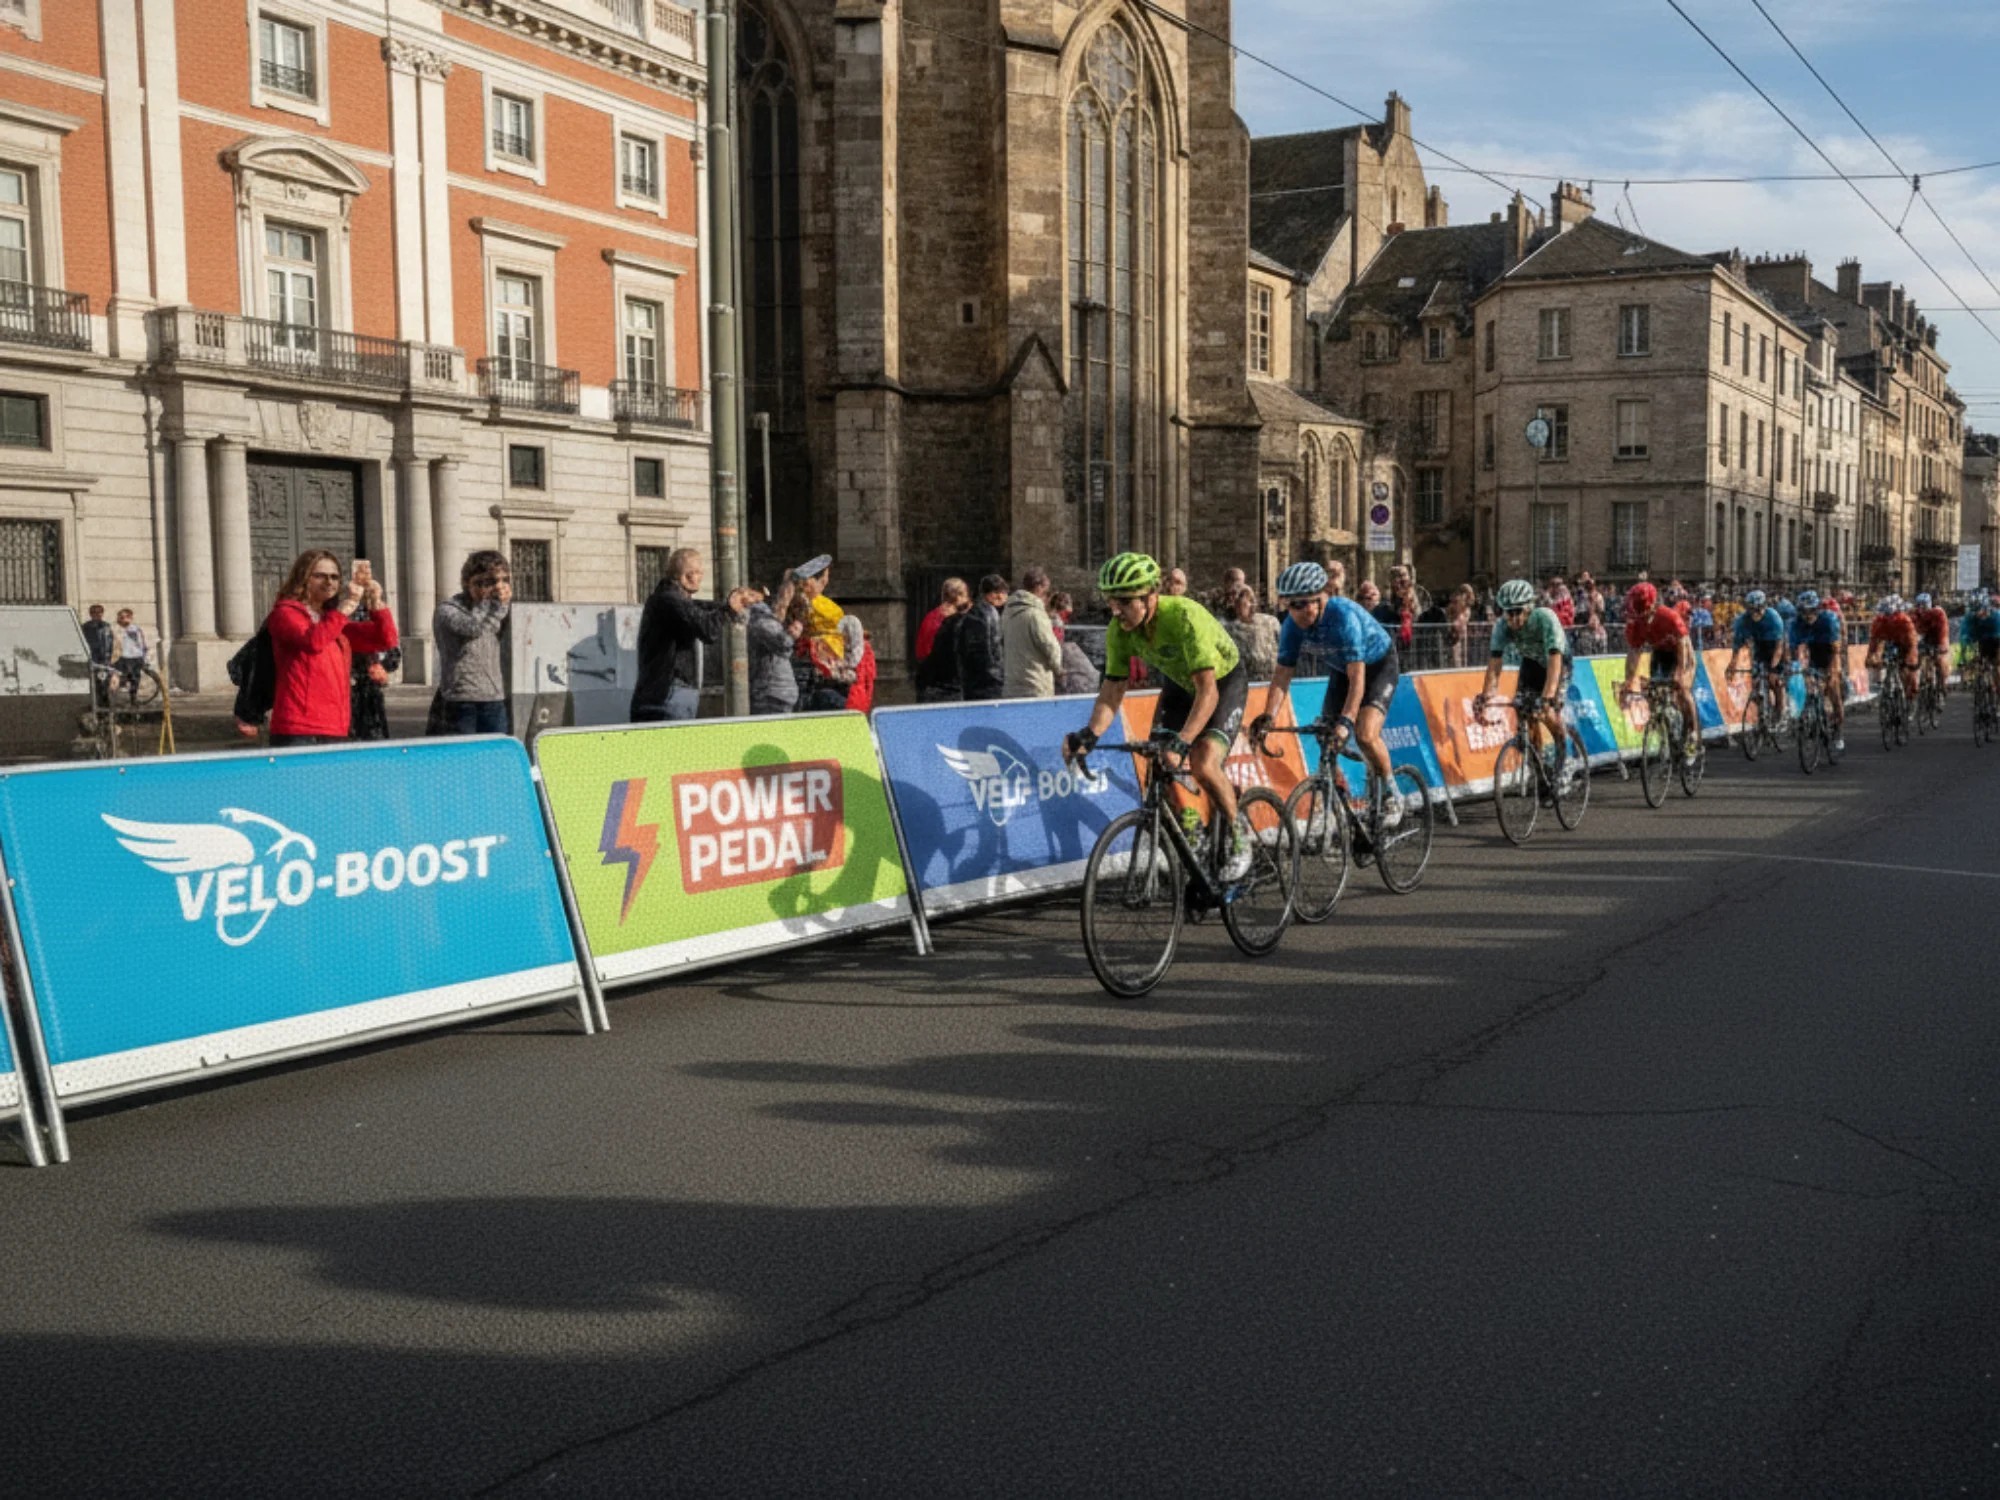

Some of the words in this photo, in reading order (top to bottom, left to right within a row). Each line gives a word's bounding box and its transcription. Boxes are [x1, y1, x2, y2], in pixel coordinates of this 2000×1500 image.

[679, 768, 833, 831] POWER
[175, 834, 498, 921] VELO-BOOST
[689, 818, 828, 883] PEDAL
